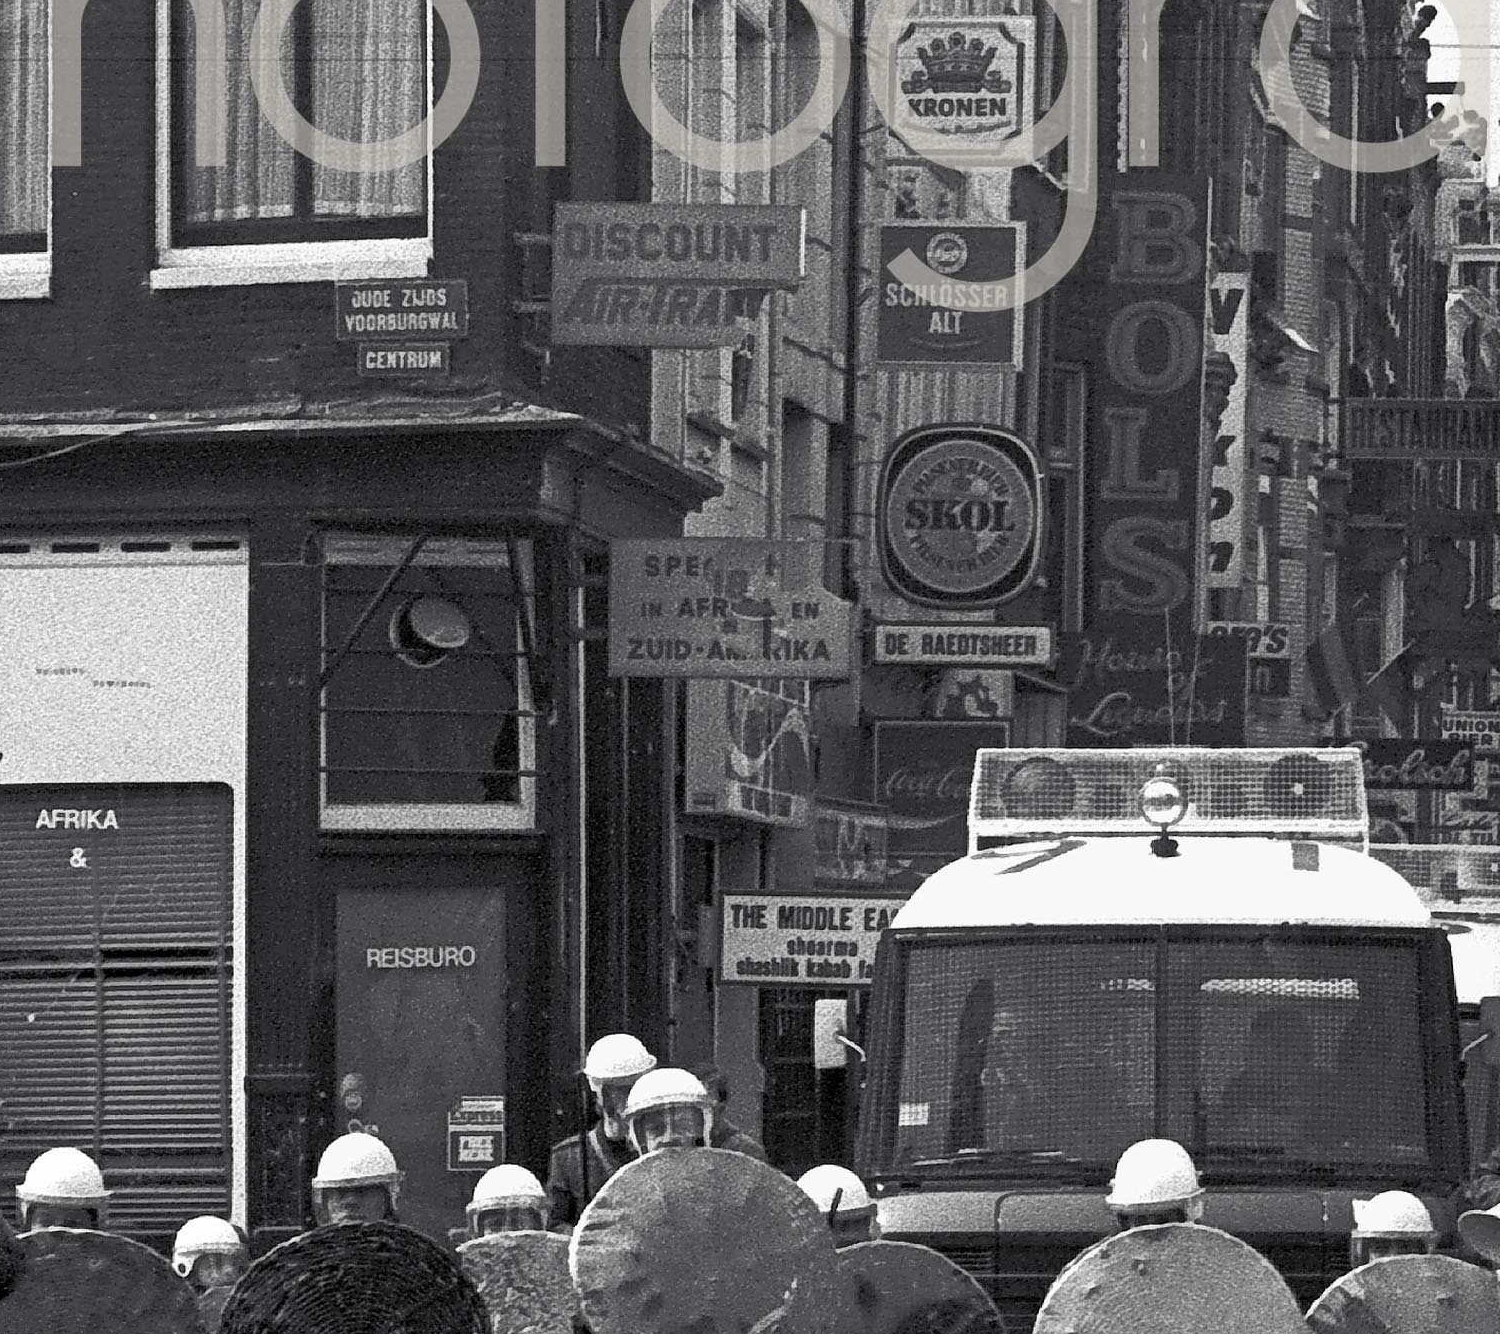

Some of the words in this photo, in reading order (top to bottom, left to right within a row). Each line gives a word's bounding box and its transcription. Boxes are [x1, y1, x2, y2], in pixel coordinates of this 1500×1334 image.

[907, 97, 1008, 118] KRONEN
[562, 222, 779, 262] DISCOUNT
[344, 311, 459, 333] VOORBURGWAL
[928, 310, 963, 335] ALT
[365, 350, 442, 369] CENTRUM
[904, 499, 1018, 532] SKOL
[791, 602, 820, 619] EN
[883, 633, 909, 656] DE
[921, 633, 1038, 656] RAEDTSHEER
[1442, 720, 1500, 733] UNION
[35, 808, 120, 830] AFRIKA
[68, 846, 88, 868] &
[730, 904, 768, 930] THE
[778, 905, 853, 931] MIDDLE
[365, 944, 477, 969] REISBURO
